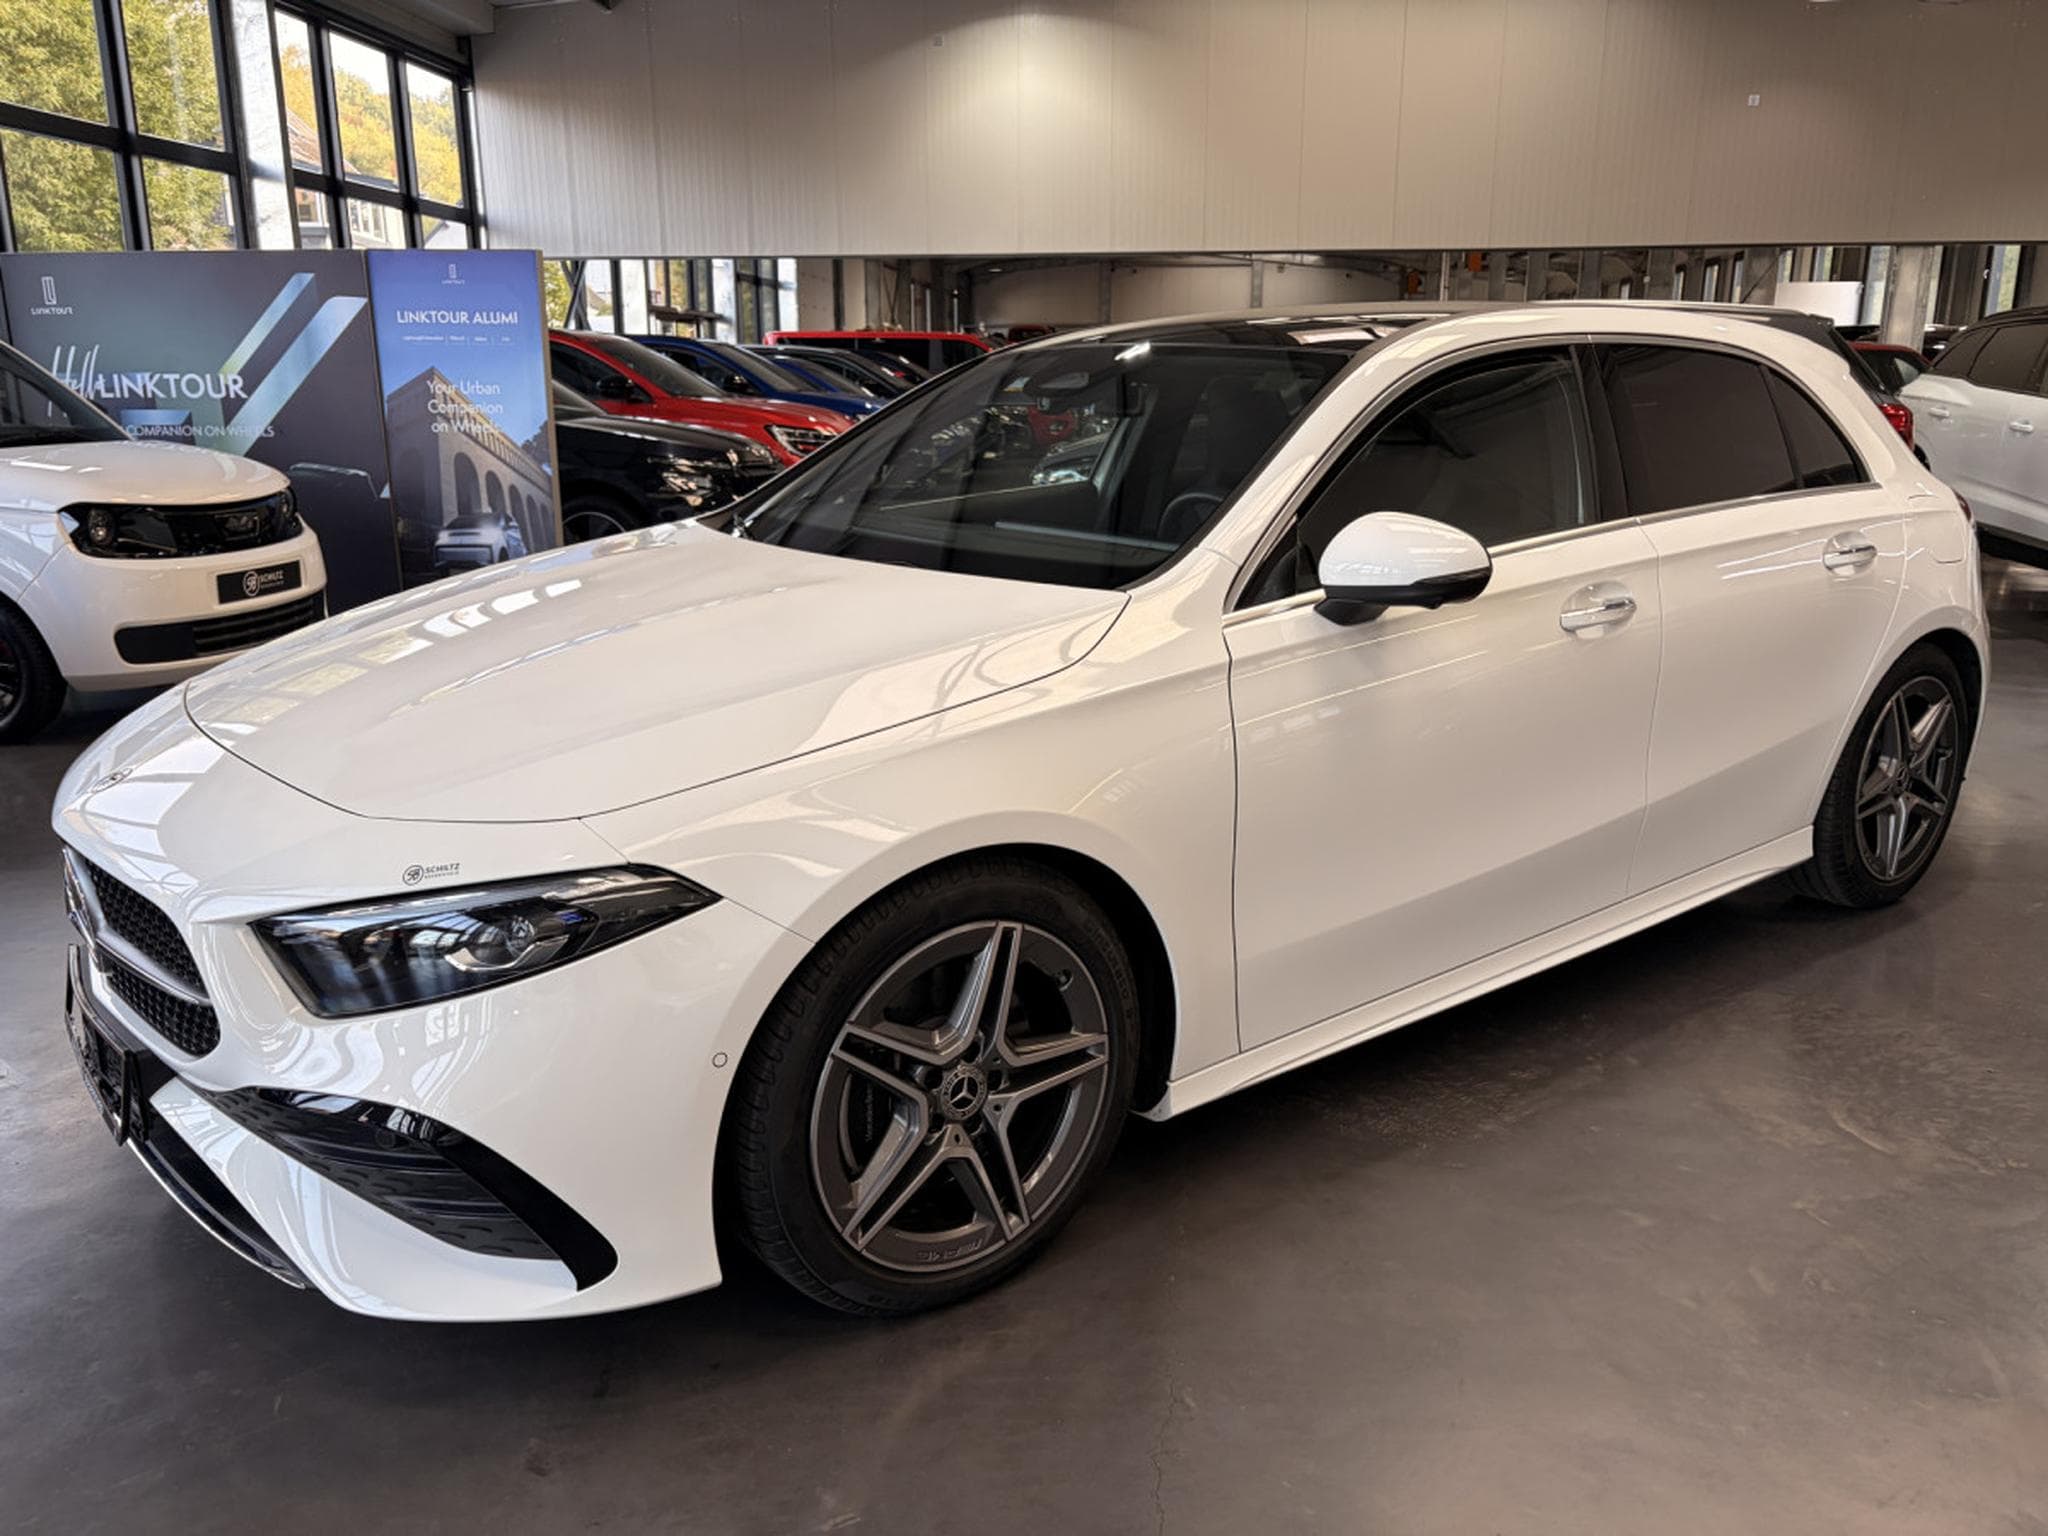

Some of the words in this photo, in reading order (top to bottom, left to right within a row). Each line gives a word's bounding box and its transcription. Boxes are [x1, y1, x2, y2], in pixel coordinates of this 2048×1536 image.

[396, 310, 469, 324] LINKTOUR
[472, 311, 518, 325] ALUMI
[99, 373, 249, 399] LINKTOUR
[426, 380, 457, 395] Your
[460, 379, 501, 395] Urban
[427, 399, 504, 417] Companion
[126, 424, 202, 437] COMPANION
[204, 424, 225, 437] ON
[431, 422, 449, 433] on
